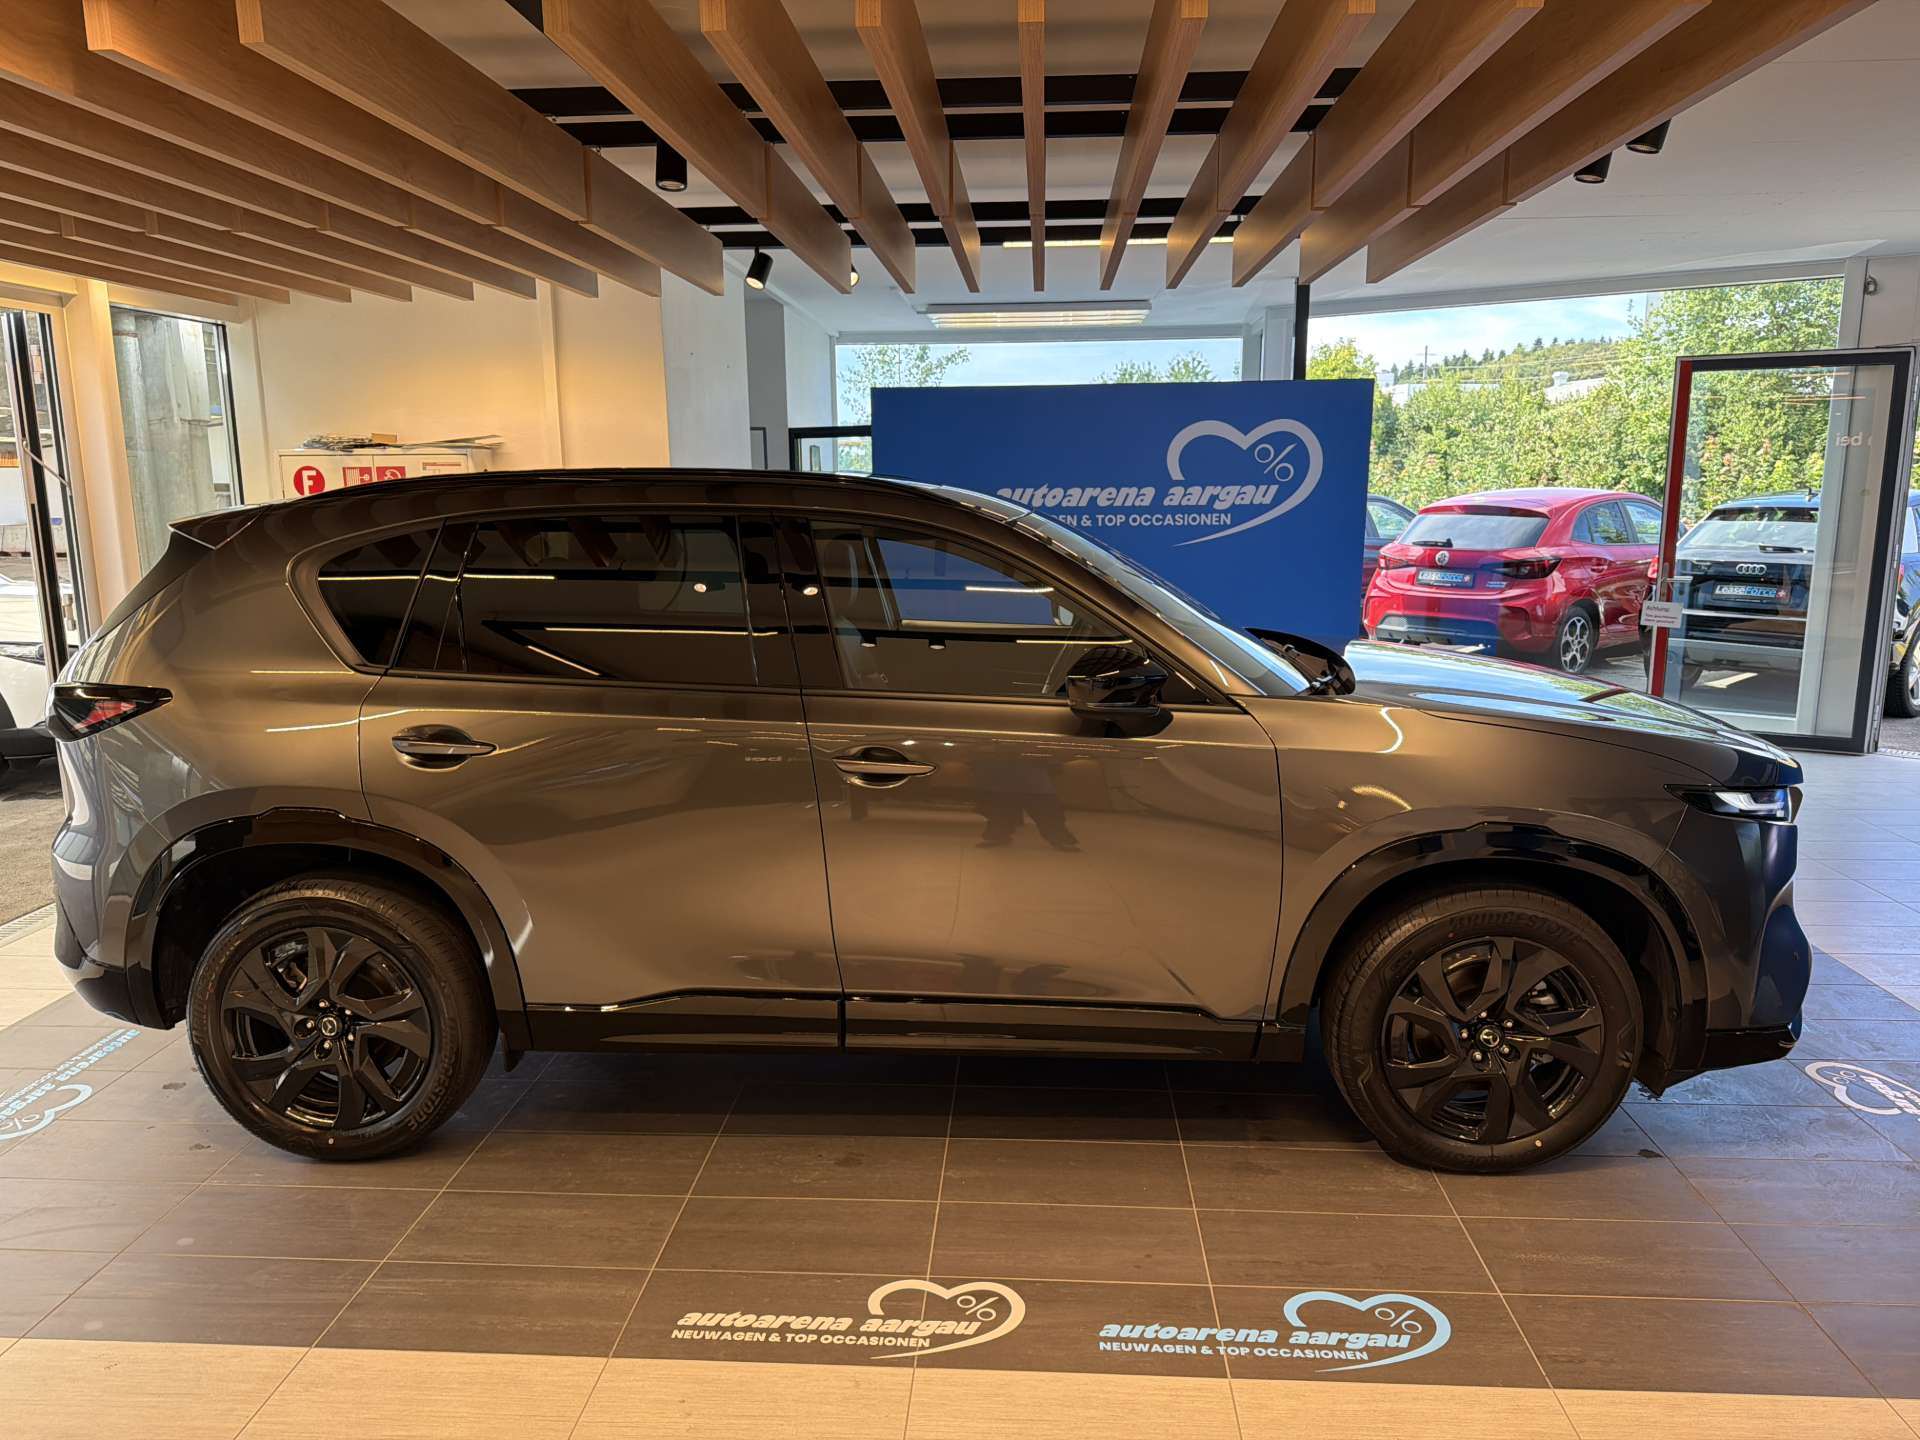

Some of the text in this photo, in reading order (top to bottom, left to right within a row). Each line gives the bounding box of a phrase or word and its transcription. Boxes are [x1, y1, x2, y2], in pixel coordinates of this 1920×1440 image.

[1163, 484, 1279, 510] aargau
[1081, 515, 1092, 527] &
[1096, 514, 1126, 527] TOP
[1129, 513, 1231, 526] OCCASIONEN
[1714, 584, 1777, 598] LeaseForce
[677, 1311, 982, 1337] autoarena aargau
[671, 1329, 931, 1348] NEUWAGEN & TOP OCCASIONEN
[1099, 1322, 1411, 1349] autoarena aargau
[1099, 1341, 1369, 1361] NEUWAGEN & TOP OCCASIONEN
